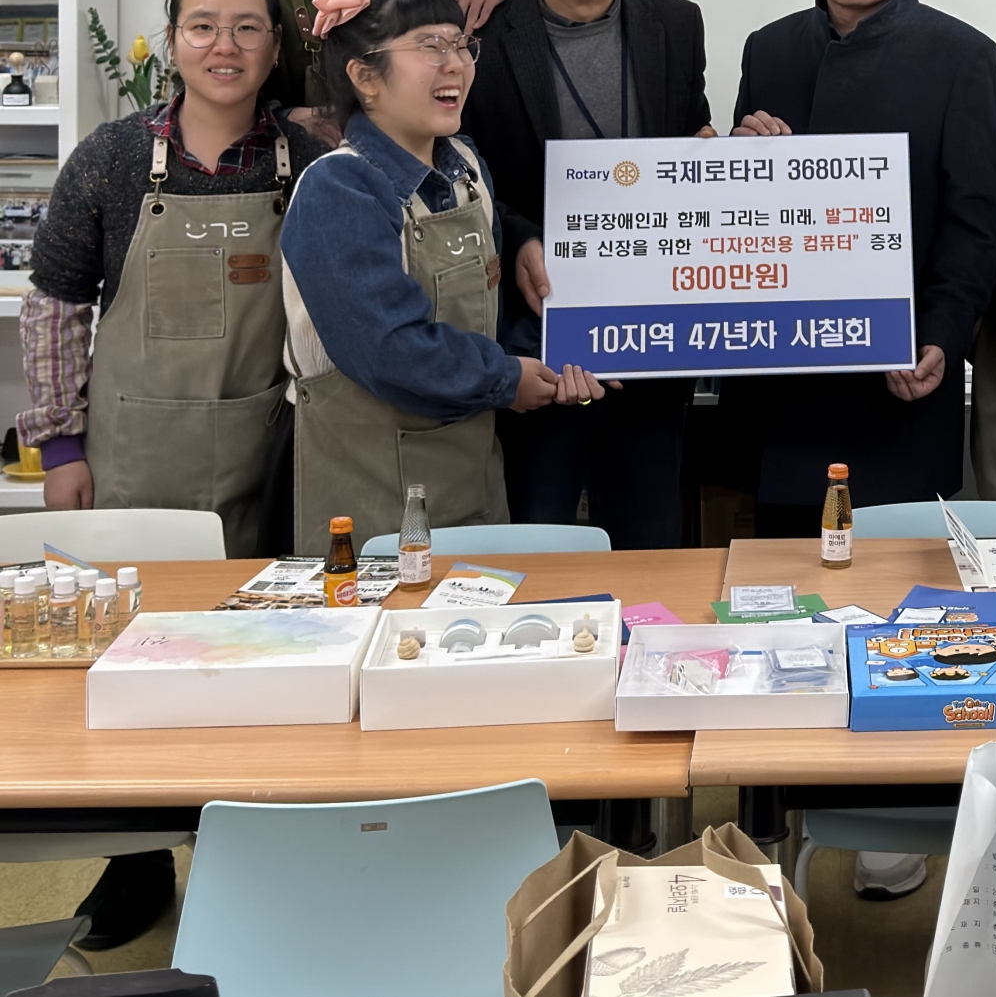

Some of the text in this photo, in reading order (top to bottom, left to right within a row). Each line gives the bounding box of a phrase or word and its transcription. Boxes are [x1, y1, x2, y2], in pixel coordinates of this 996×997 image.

[566, 168, 610, 182] Rotary
[656, 156, 889, 184] 국제로타리 3680지구
[566, 206, 891, 231] 발달장애인과 함께 그리는 미래, 발그래의
[554, 241, 588, 259] 매출
[597, 239, 648, 257] 신장을
[658, 238, 692, 256] 위한
[870, 233, 903, 251] 증정
[672, 263, 789, 291] (300만원)
[588, 317, 871, 354] 10지역 47년차 사칠회
[943, 704, 995, 722] School!
[667, 884, 689, 913] 오리지널
